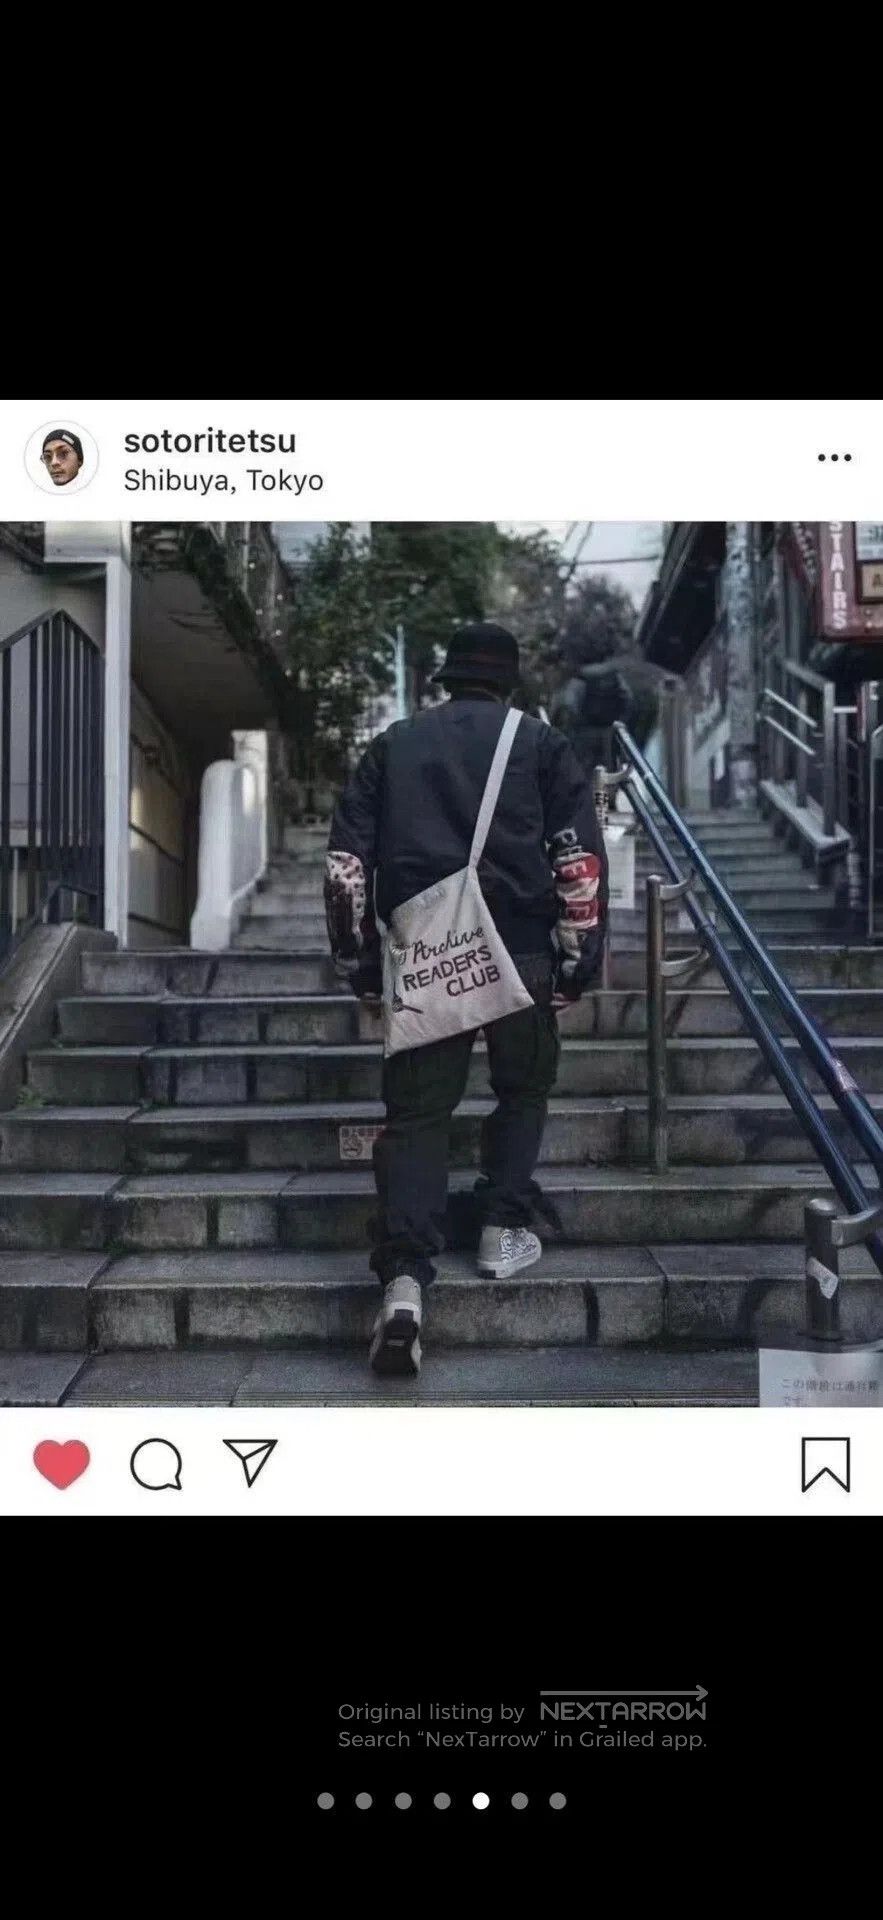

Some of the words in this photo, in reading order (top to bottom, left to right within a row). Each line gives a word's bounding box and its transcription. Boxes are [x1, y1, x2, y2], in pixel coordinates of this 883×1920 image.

[412, 927, 484, 964] Archive
[402, 945, 492, 992] READERS
[446, 965, 500, 997] CLUB
